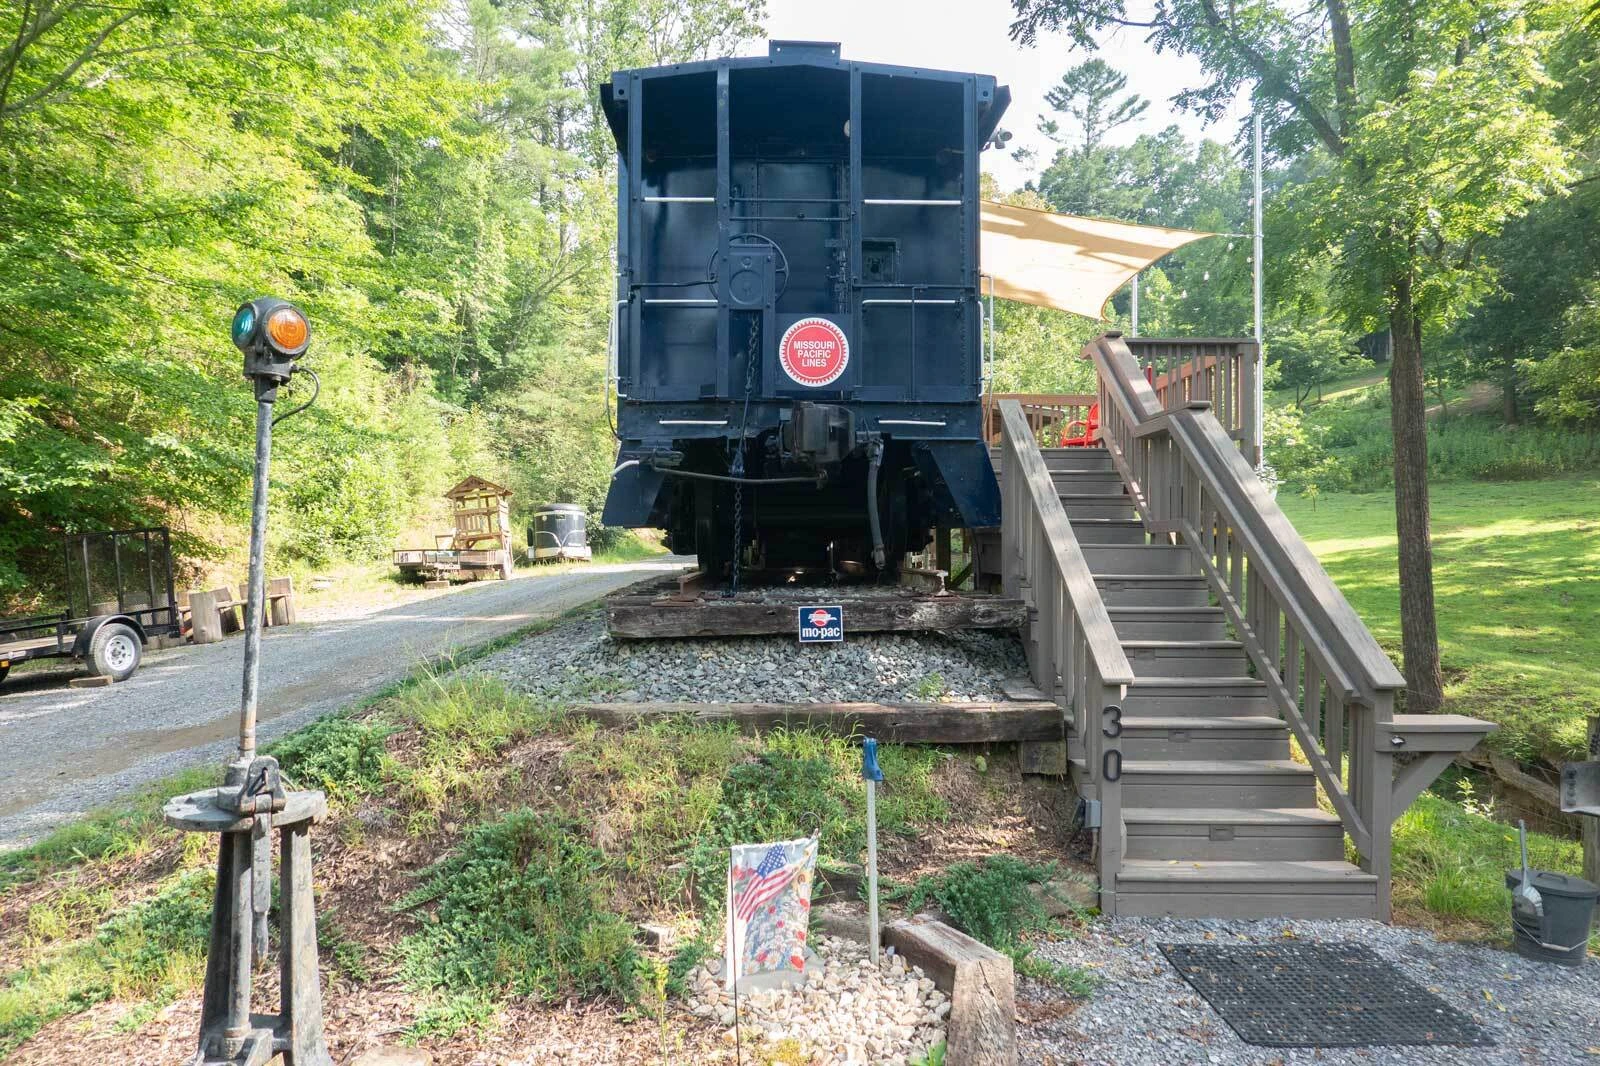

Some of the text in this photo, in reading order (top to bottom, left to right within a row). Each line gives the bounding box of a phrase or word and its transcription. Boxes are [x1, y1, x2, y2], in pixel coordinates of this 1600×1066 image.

[793, 341, 835, 350] MISSOURI
[797, 350, 832, 358] PACIFIC
[802, 358, 827, 367] LINES
